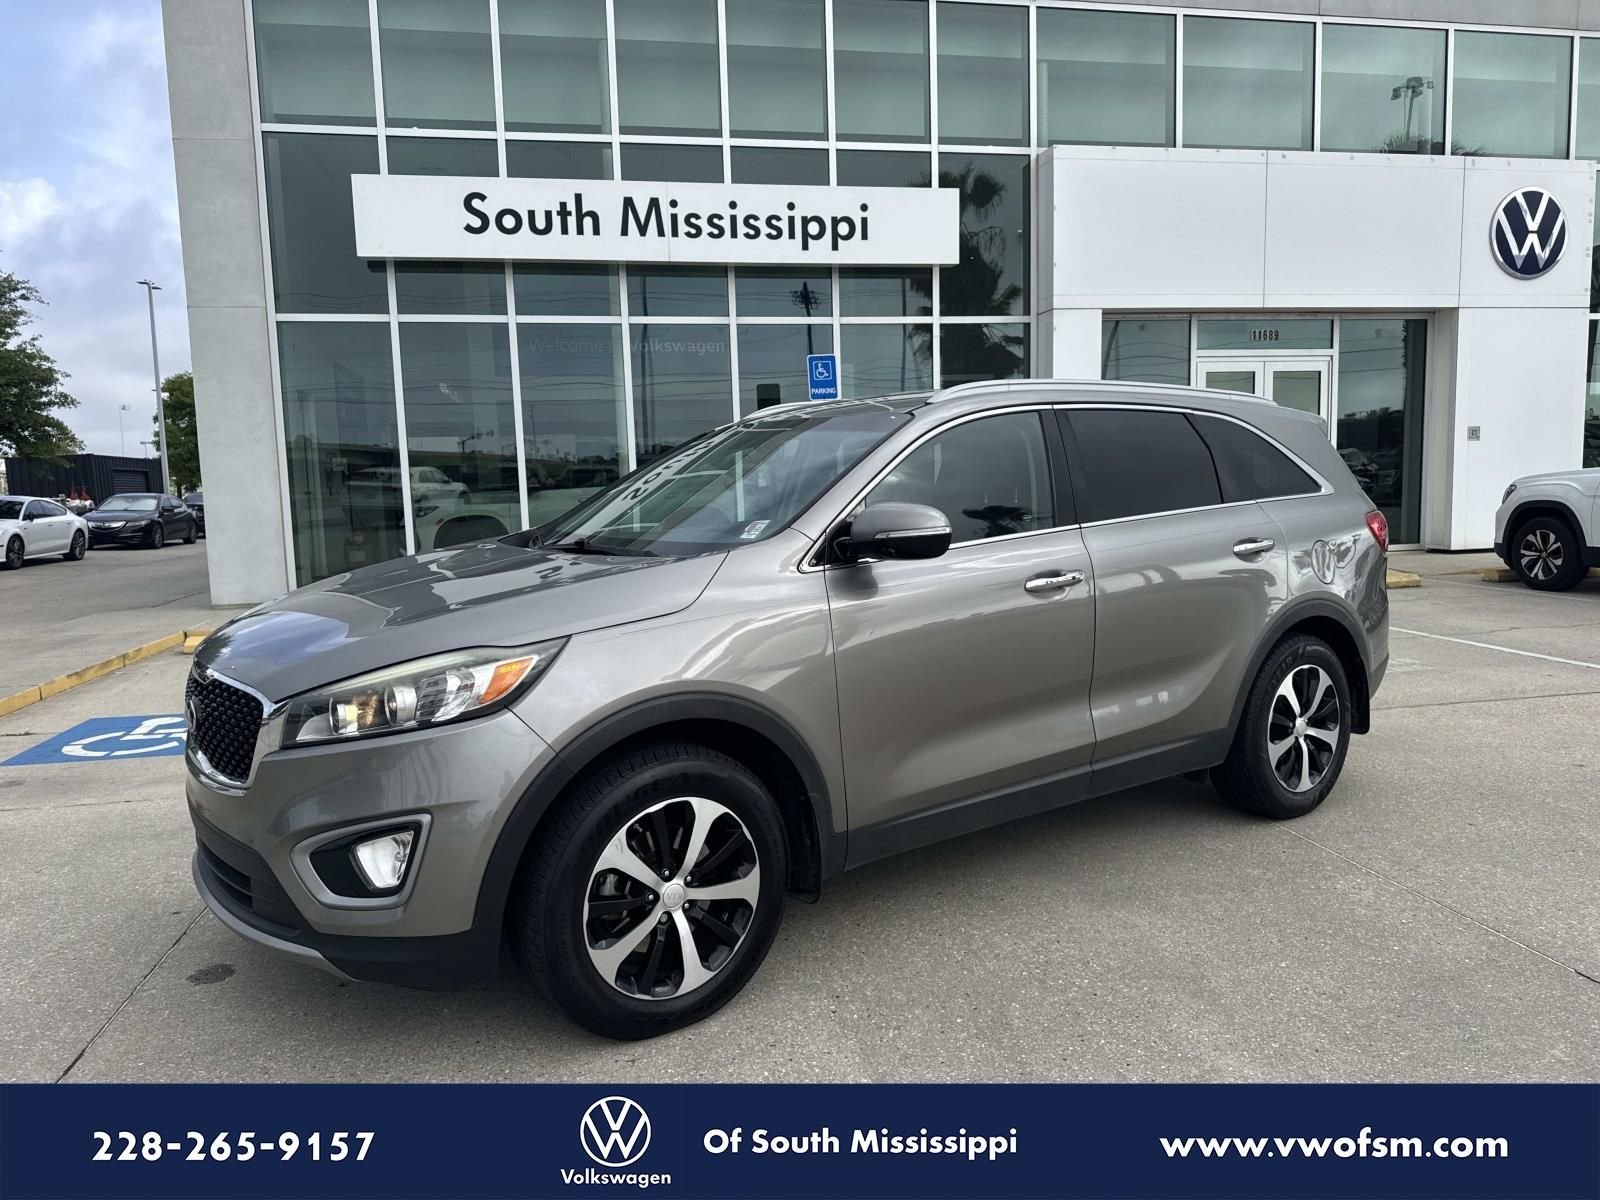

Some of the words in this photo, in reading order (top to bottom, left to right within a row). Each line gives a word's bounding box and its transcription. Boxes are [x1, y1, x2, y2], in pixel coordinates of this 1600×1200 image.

[464, 192, 600, 236] South
[621, 197, 869, 251] Mississippi
[528, 338, 604, 353] Welcome
[629, 338, 725, 356] Volkswagen
[811, 387, 837, 395] PARKING
